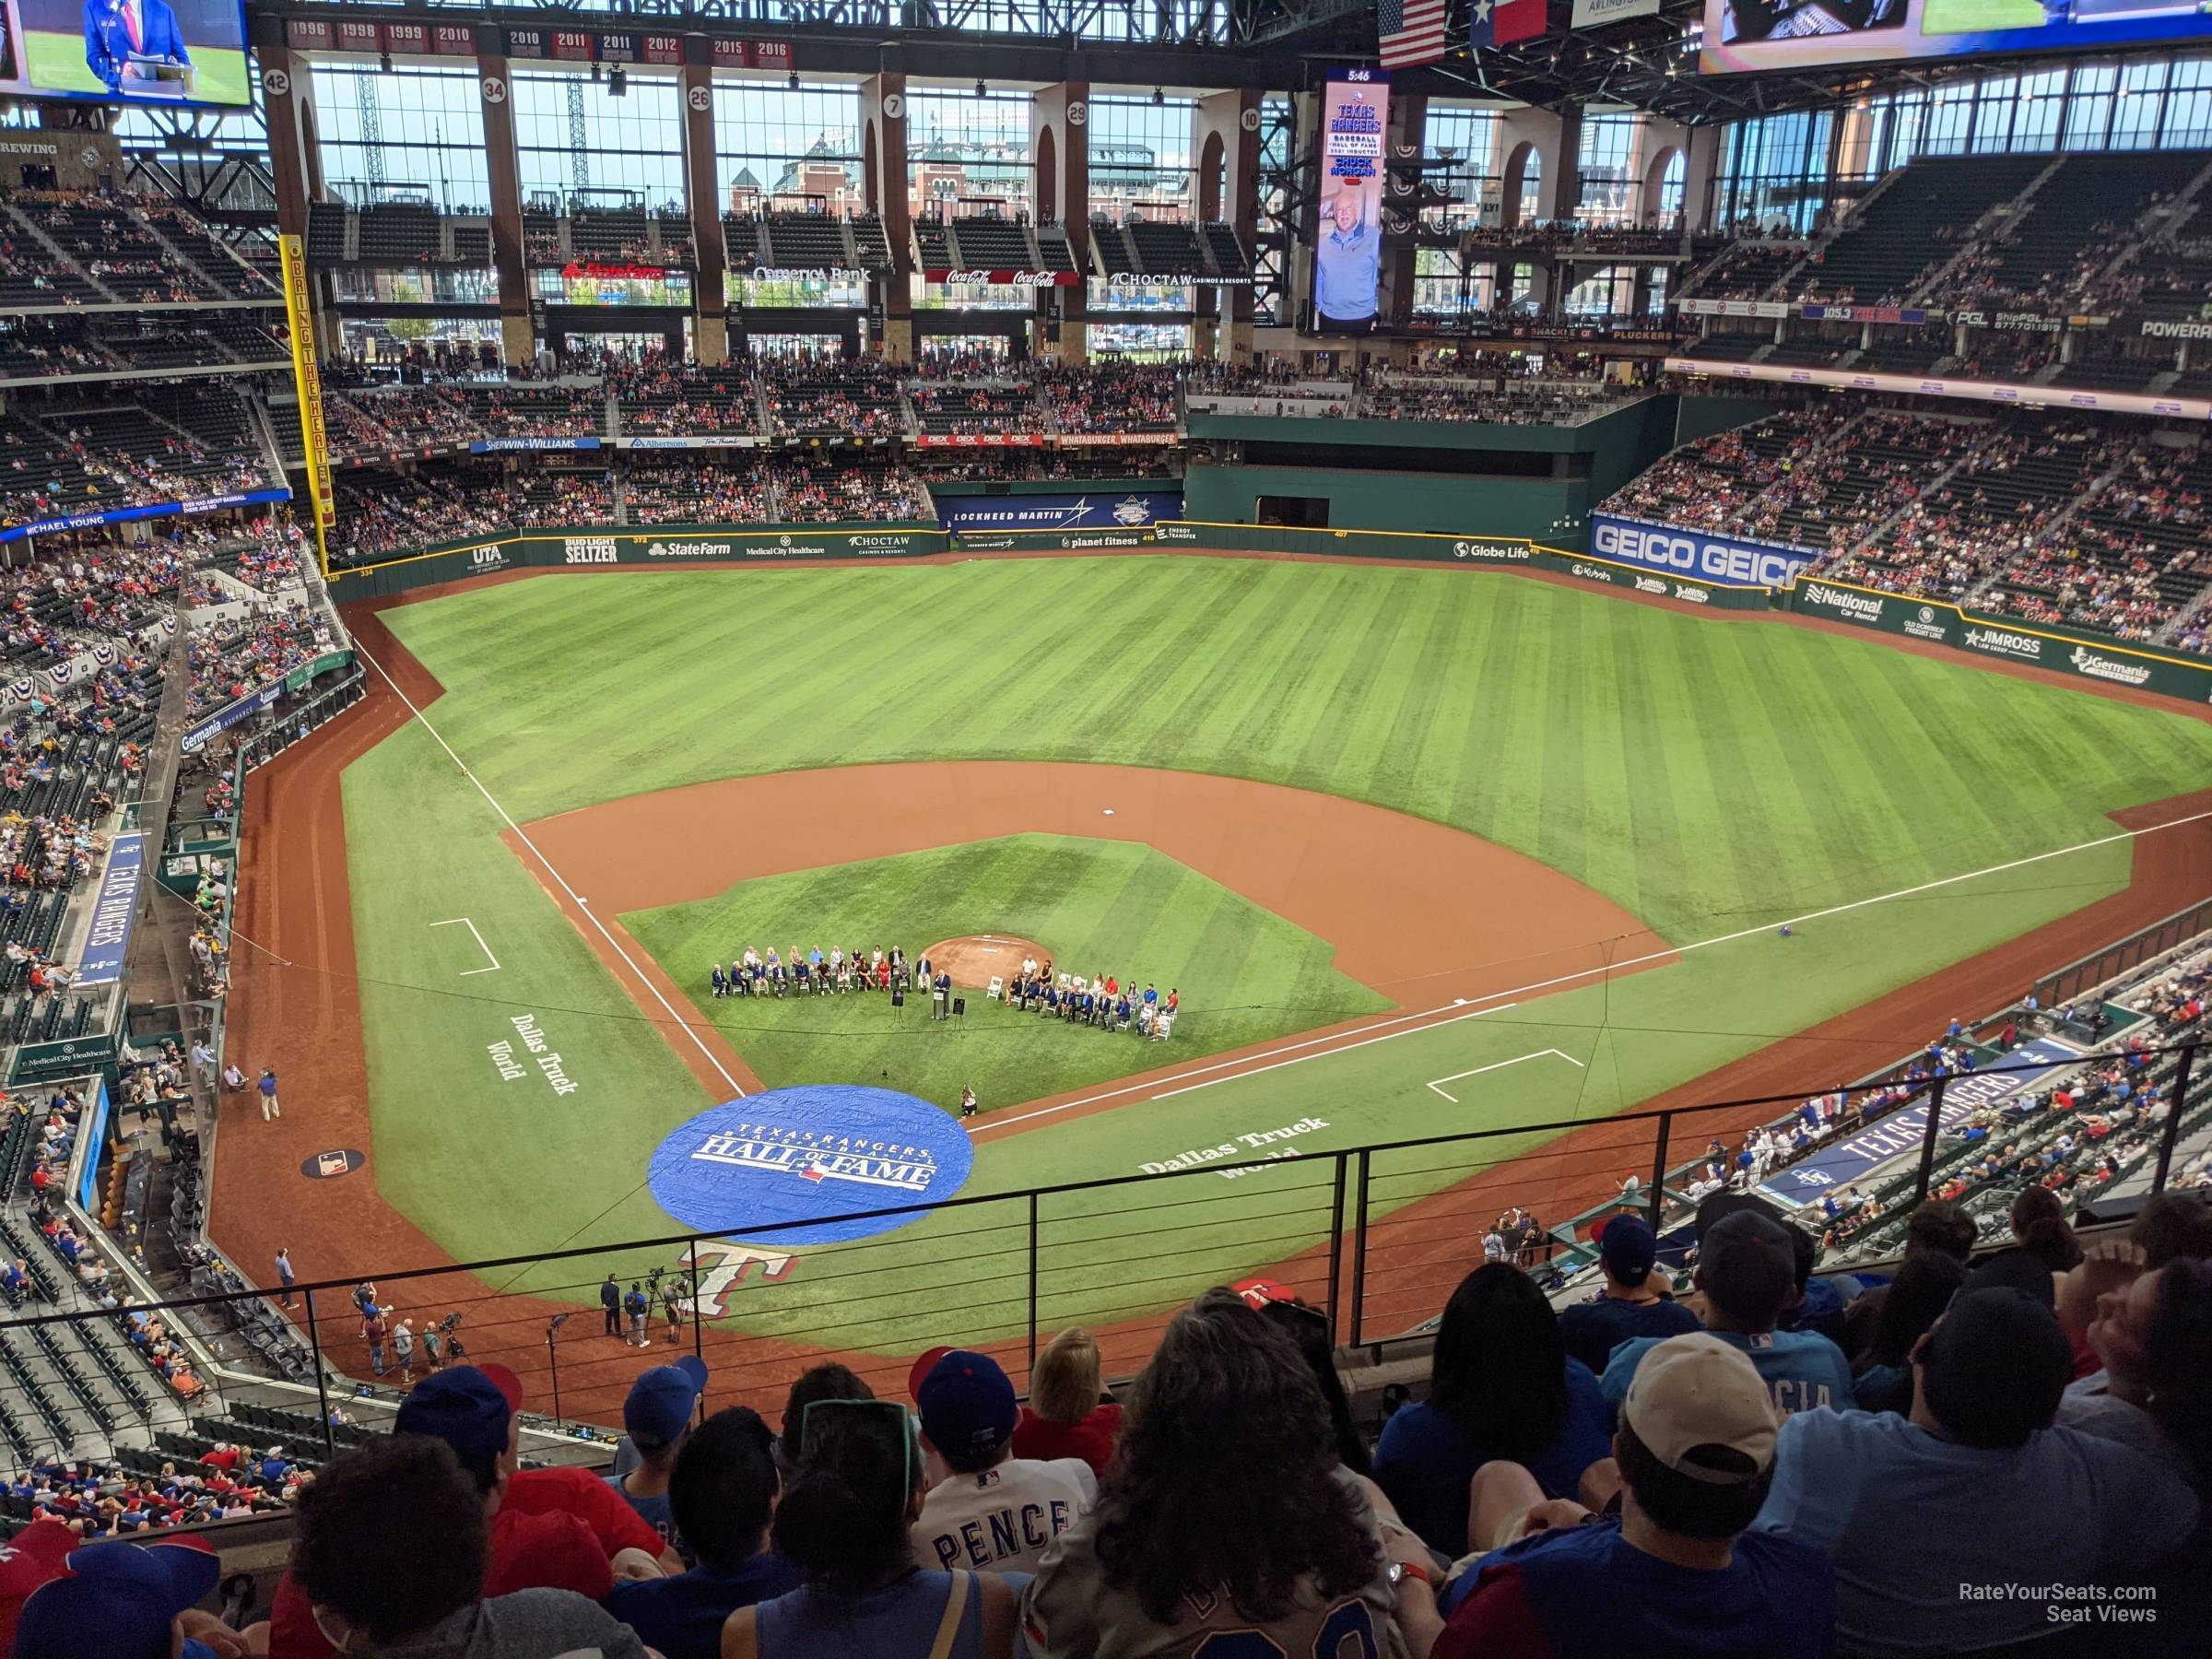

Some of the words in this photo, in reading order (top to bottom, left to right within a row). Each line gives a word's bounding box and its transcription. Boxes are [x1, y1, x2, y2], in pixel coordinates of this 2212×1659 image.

[293, 22, 325, 36] 1996
[343, 23, 376, 38] 1998
[389, 25, 422, 40] 1999
[439, 29, 470, 41] 2010
[510, 31, 540, 44] 2010
[558, 33, 586, 47] 2011
[603, 35, 630, 49] 2011
[648, 38, 677, 51] 2012
[714, 41, 743, 54] 2015
[758, 42, 786, 56] 2016
[1347, 69, 1370, 81] 5:46
[265, 75, 288, 90] 42
[484, 83, 504, 97] 34
[691, 90, 709, 105] 26
[889, 100, 900, 112] 7
[1069, 106, 1086, 121] 29
[1244, 112, 1257, 126] 10
[830, 266, 872, 282] Bank
[946, 269, 992, 287] Coca-Cola
[1013, 270, 1058, 288] Coca-Cola
[1118, 273, 1192, 287] CHOCTAW
[1823, 307, 1851, 320] 105.3
[1956, 312, 1988, 325] PGL
[645, 440, 688, 448] Albertsons
[928, 435, 948, 443] DEX
[955, 435, 976, 443] DEX
[982, 435, 1004, 443] DEX
[1010, 435, 1031, 443] DEX
[1061, 434, 1116, 445] WHATABURGER
[1120, 434, 1175, 444] WHATABURGER
[954, 512, 1015, 522] LOCKHEED
[1018, 512, 1063, 521] MARTIN
[26, 520, 68, 536] MICHAEL
[69, 516, 105, 528] YOUNG
[565, 538, 586, 547] BUD
[855, 535, 910, 546] CHOCTAW
[1071, 537, 1103, 549] planet
[1104, 536, 1138, 547] fitness
[1594, 524, 1696, 570] GEICO
[472, 546, 502, 564] UTA
[565, 546, 618, 564] SELTZER
[773, 547, 787, 556] City
[788, 547, 825, 555] Healthcare
[1470, 545, 1506, 558] Globe
[1507, 547, 1530, 559] Life
[1583, 567, 1611, 582] Kubota
[1821, 589, 1883, 614] National
[1841, 608, 1853, 617] Car
[1854, 610, 1878, 622] Rental
[2092, 655, 2150, 680] Germania
[182, 719, 222, 751] Germania
[221, 706, 253, 729] INSURANCE
[104, 864, 140, 897] TEXAS
[91, 897, 132, 947] RANGERS
[29, 1056, 56, 1066] Medical
[56, 1054, 72, 1063] City
[73, 1049, 112, 1060] Healthcare
[487, 1040, 528, 1081] World
[510, 1013, 548, 1053] Dallas
[536, 1052, 579, 1096] Truck
[738, 1124, 813, 1141] TEXAS
[821, 1135, 931, 1158] RANGERS
[1841, 1115, 1927, 1161] TEXAS
[1137, 1143, 1238, 1175] Dallas
[1236, 1117, 1331, 1147] Truck
[697, 1136, 801, 1166] HALL
[805, 1151, 830, 1162] OF
[830, 1156, 937, 1185] FAME
[932, 1500, 1069, 1572] PENCE
